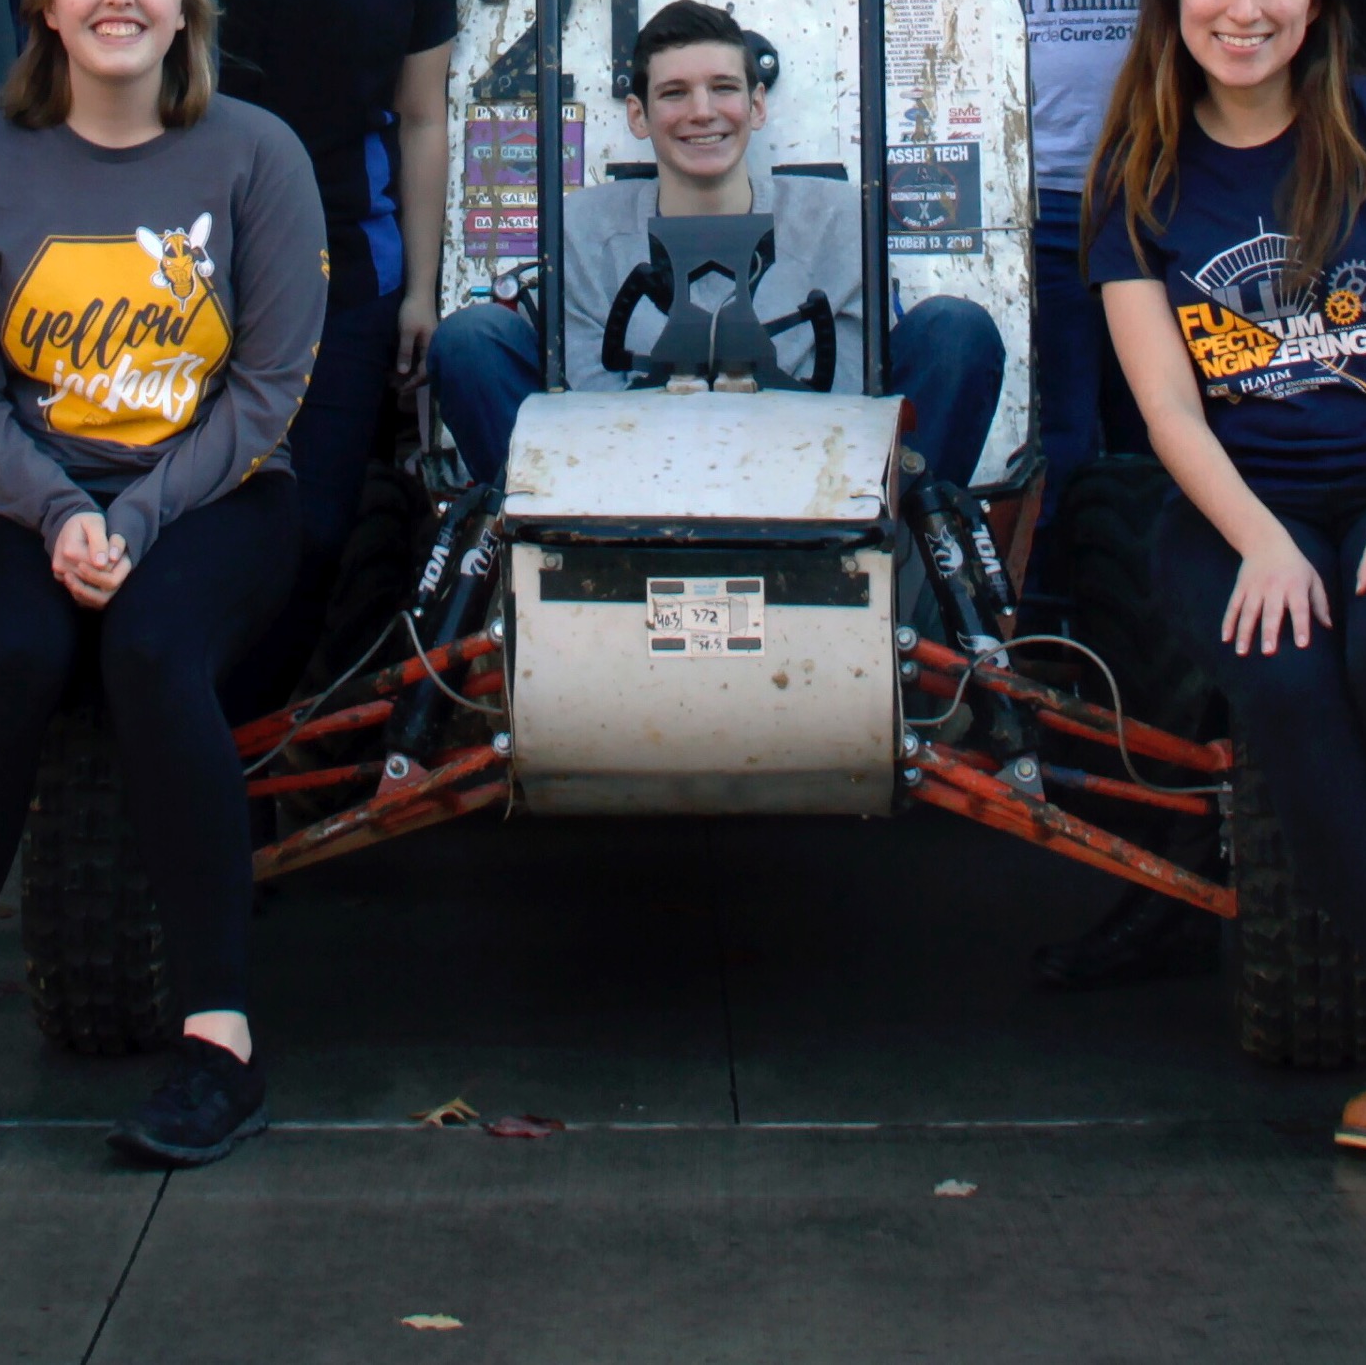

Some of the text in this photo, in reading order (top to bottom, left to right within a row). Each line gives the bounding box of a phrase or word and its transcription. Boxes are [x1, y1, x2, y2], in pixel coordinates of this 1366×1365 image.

[949, 106, 981, 117] SMC
[934, 145, 969, 162] TECH
[476, 218, 506, 229] BAA
[887, 236, 926, 249] CTOBER
[20, 291, 213, 371] yellow
[37, 352, 205, 423] jackets
[1239, 368, 1293, 394] HAJIM
[690, 608, 718, 624] 372
